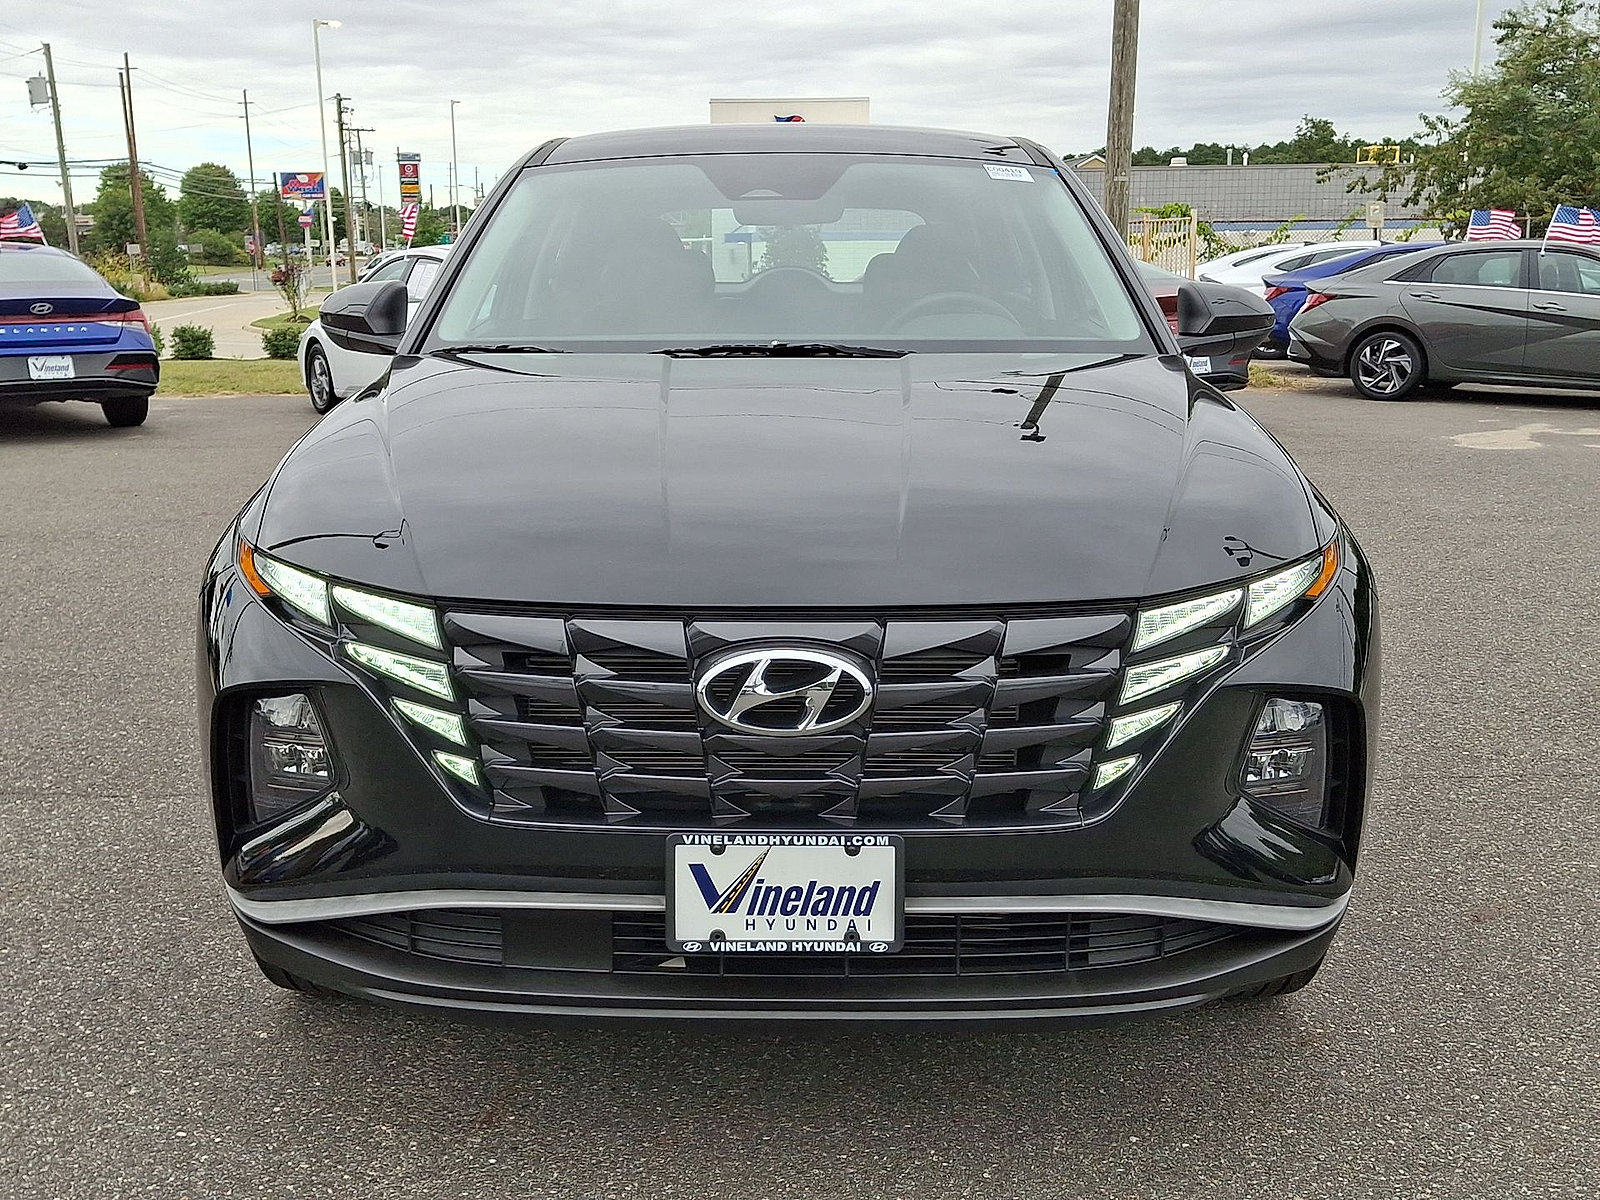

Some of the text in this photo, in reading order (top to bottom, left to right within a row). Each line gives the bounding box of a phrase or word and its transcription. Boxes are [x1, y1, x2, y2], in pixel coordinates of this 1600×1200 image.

[32, 359, 70, 372] Vineland
[682, 834, 890, 846] VINELANDHYUNDAI.COM
[687, 846, 882, 917] Vineland
[745, 918, 872, 932] HYUNDAI
[709, 941, 862, 952] VINELAND HYUNDAI
